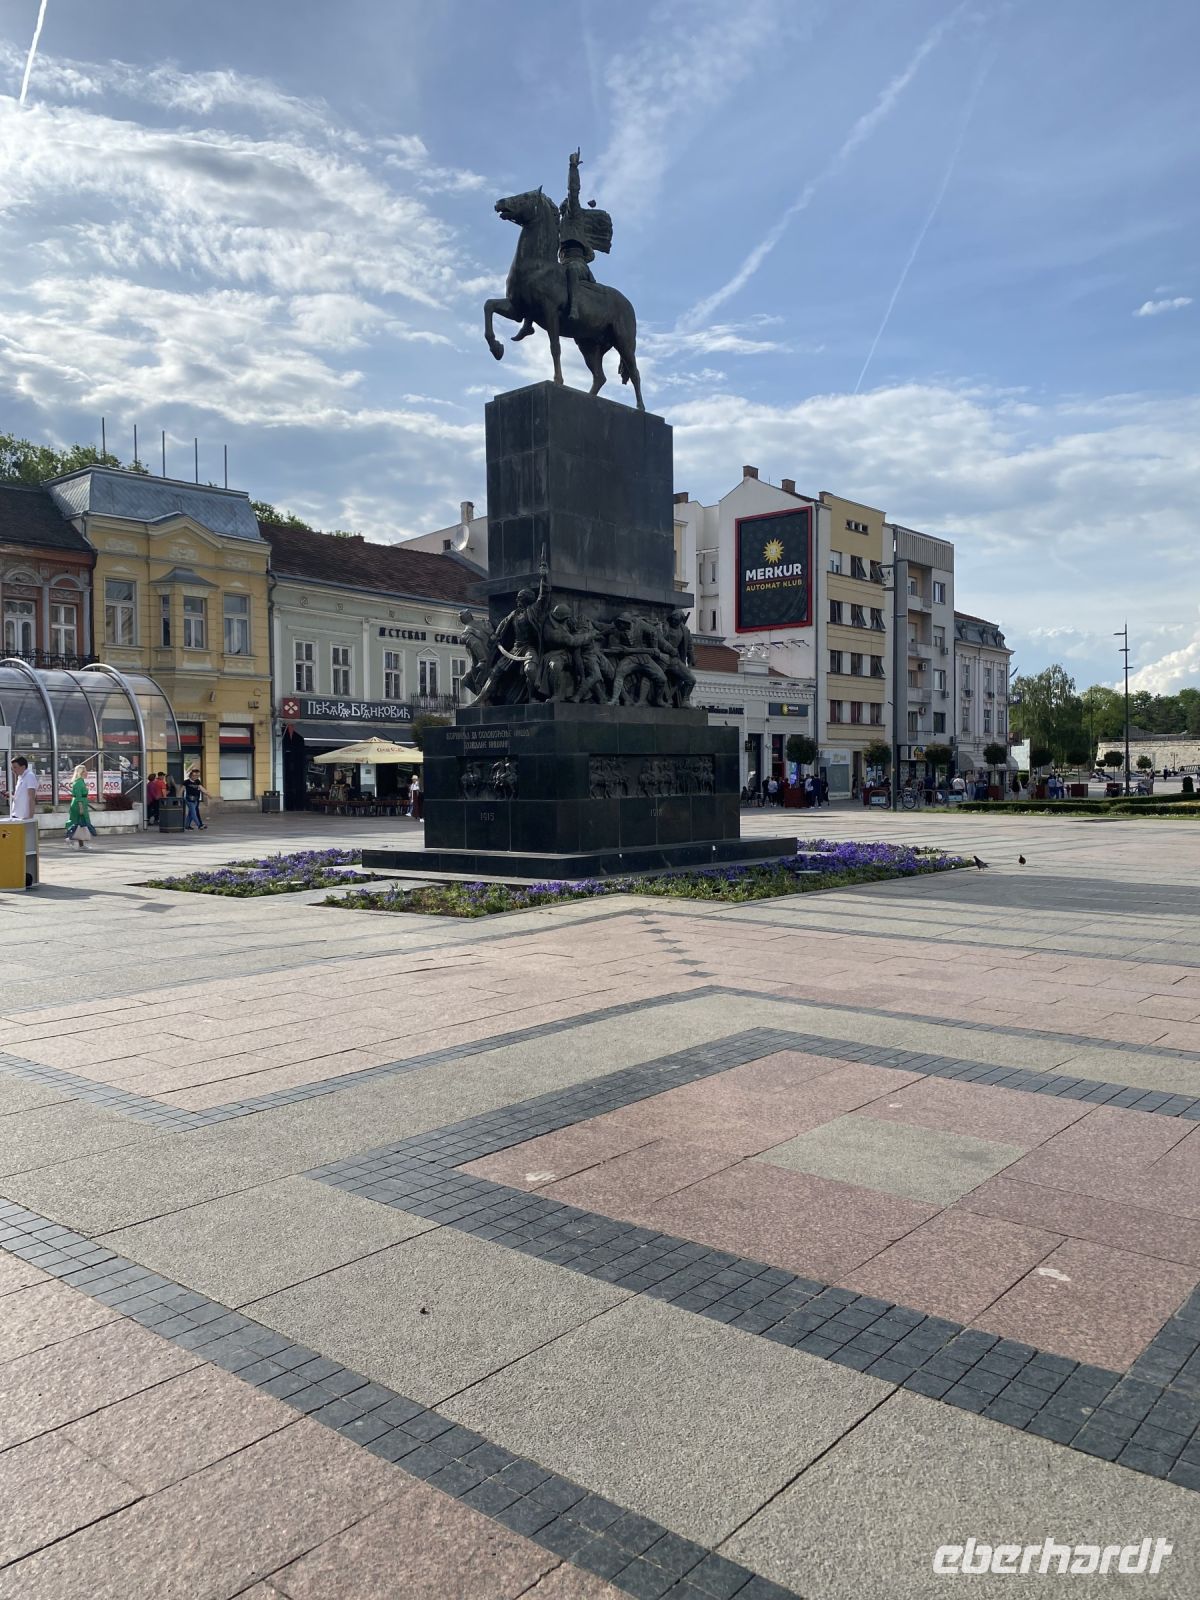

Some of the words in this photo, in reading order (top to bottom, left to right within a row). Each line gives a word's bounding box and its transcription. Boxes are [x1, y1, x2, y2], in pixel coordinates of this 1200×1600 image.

[745, 563, 802, 582] MERKUR
[746, 581, 781, 592] AUTOMAT
[782, 578, 802, 588] KLUB
